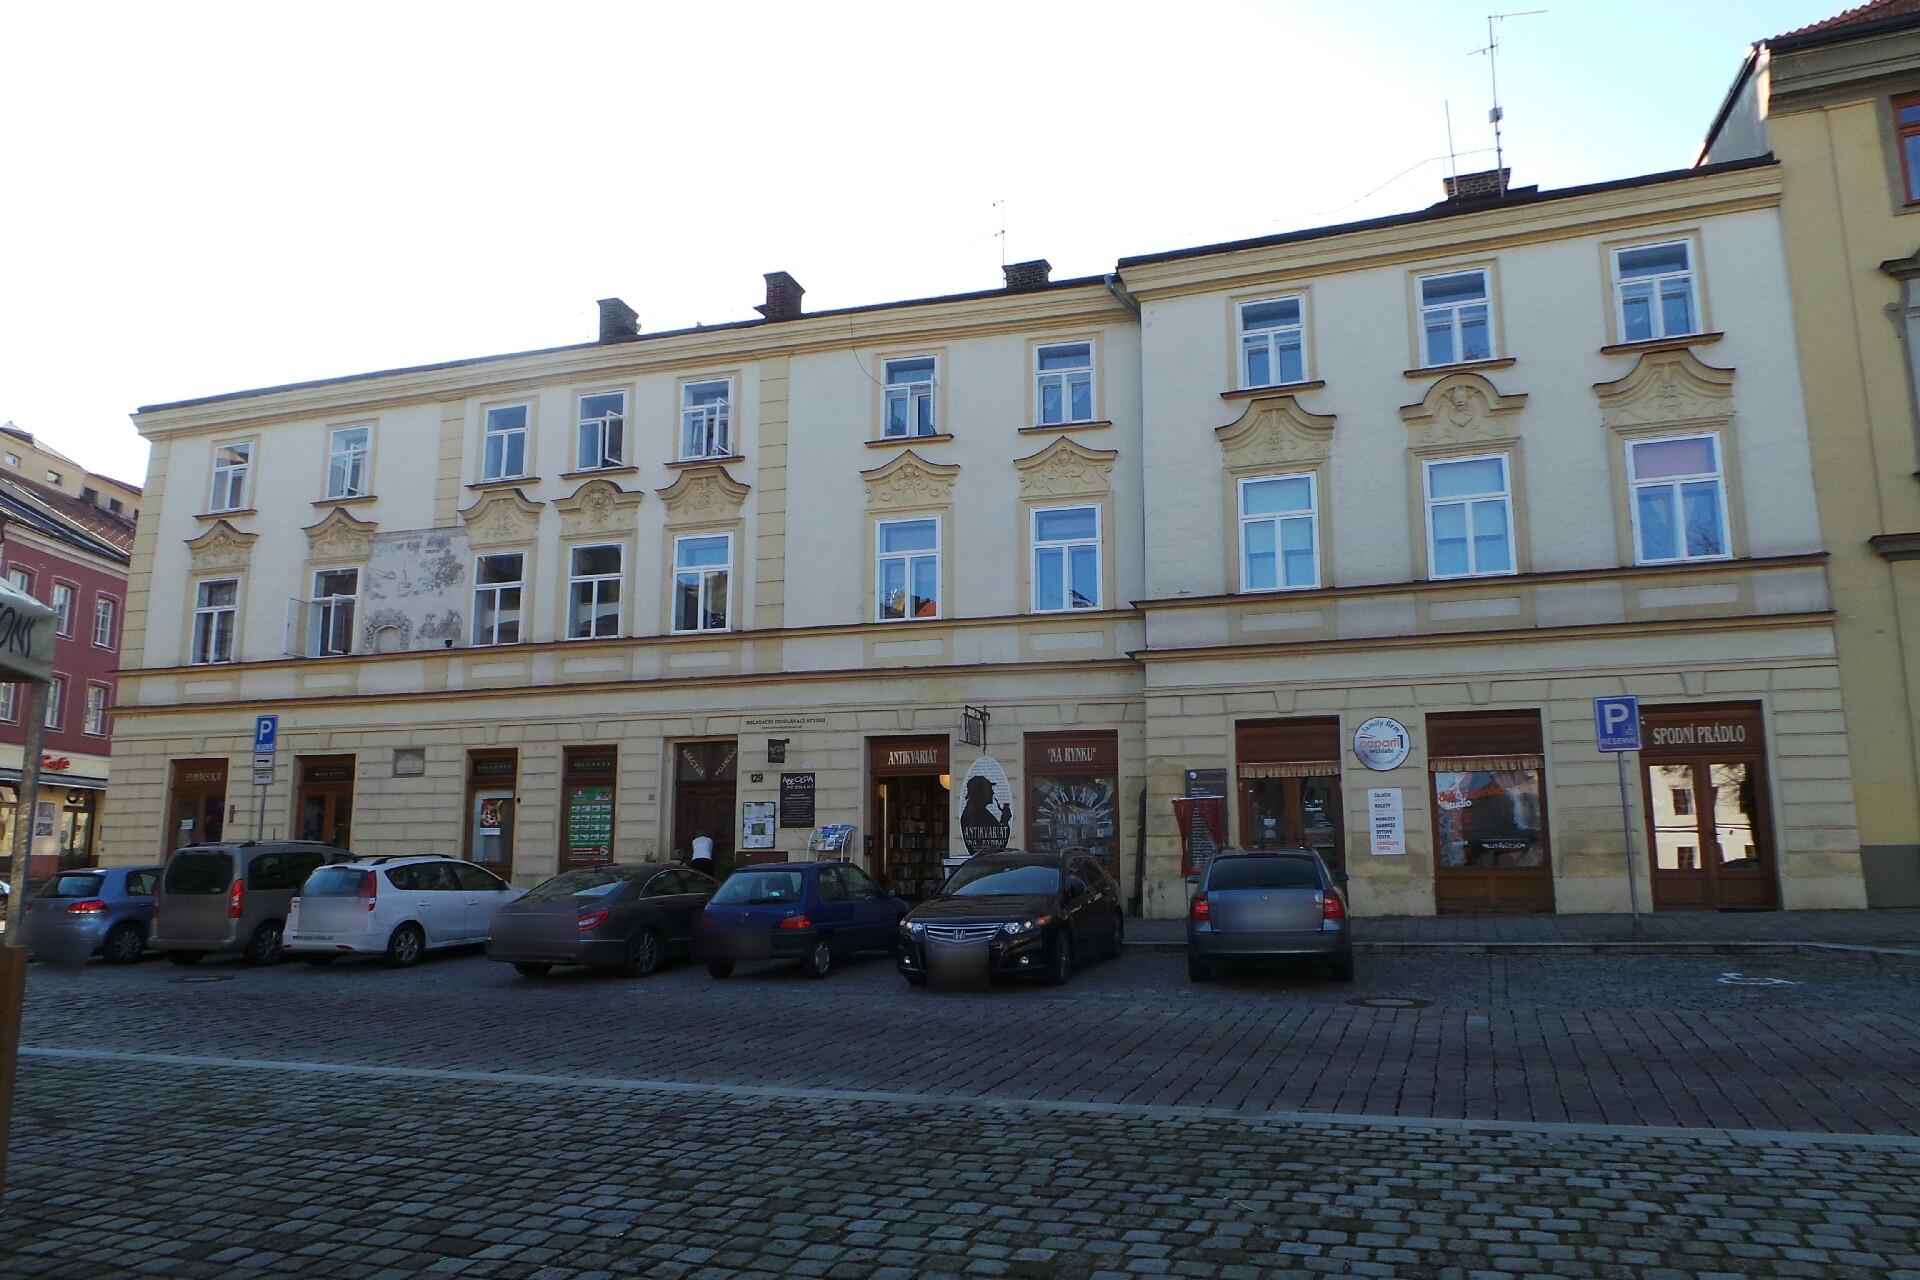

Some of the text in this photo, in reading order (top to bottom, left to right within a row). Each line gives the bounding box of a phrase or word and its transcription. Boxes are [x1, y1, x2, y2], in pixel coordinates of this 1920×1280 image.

[1603, 703, 1629, 734] P
[259, 720, 272, 741] P
[1653, 722, 1745, 744] SPODNÍ PRÁDLO
[888, 747, 938, 765] ANTIKVARIÁT
[782, 775, 813, 785] ABECEDA
